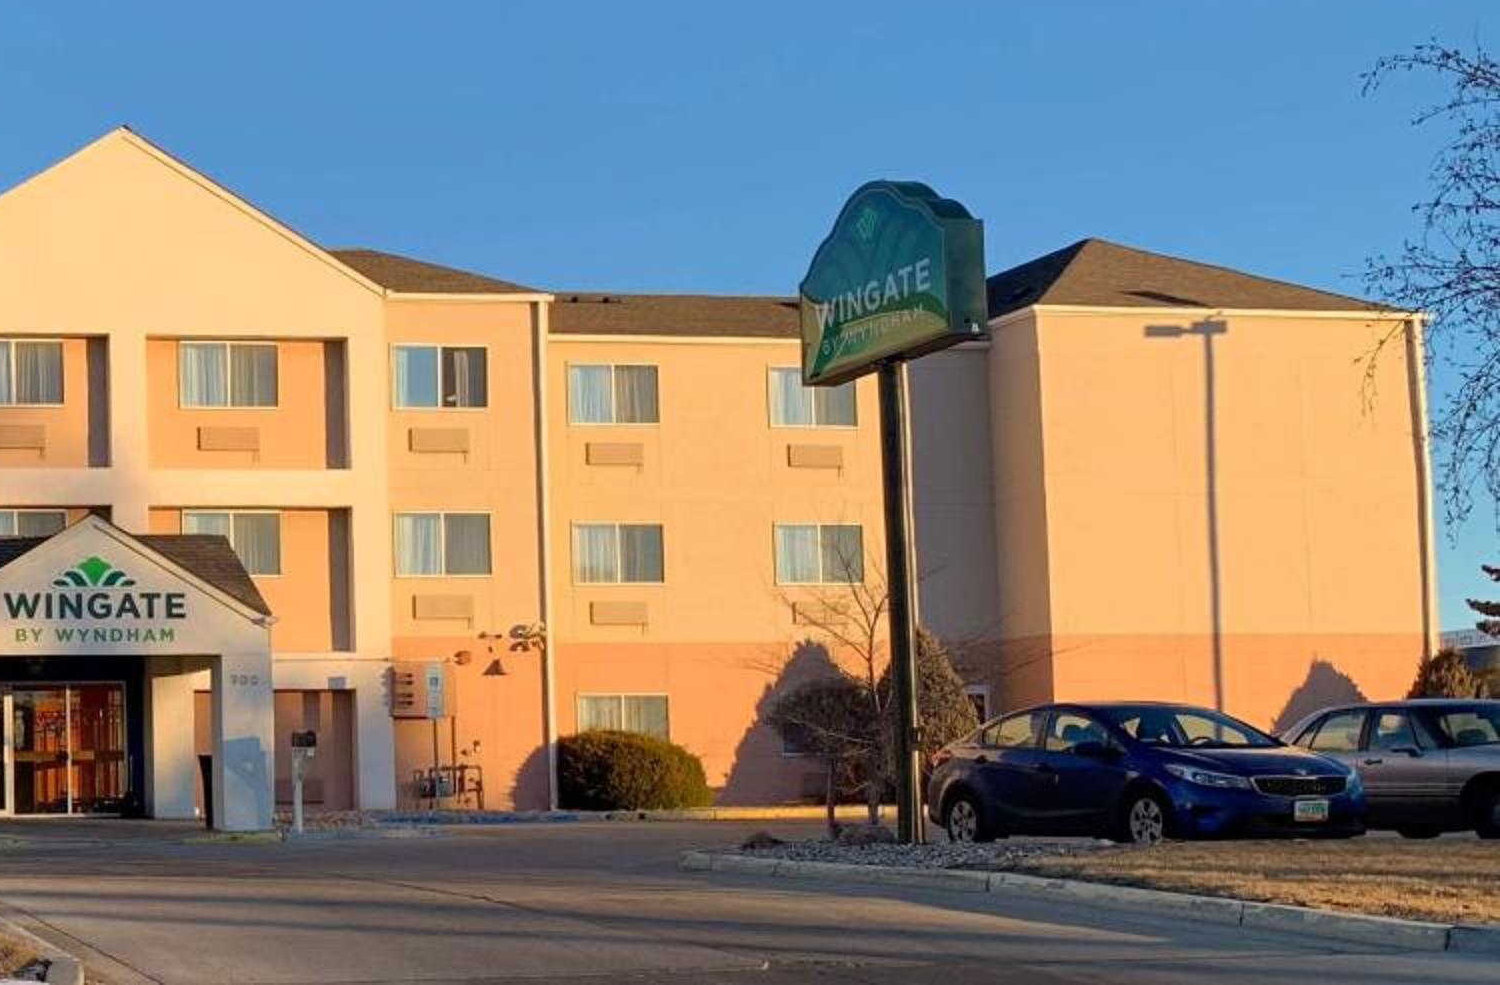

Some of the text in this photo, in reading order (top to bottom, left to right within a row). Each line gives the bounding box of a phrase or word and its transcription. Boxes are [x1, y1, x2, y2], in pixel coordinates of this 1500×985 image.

[815, 258, 932, 329] WINGATE
[3, 592, 187, 619] WINGATE
[15, 628, 175, 643] BY WYNDHAM
